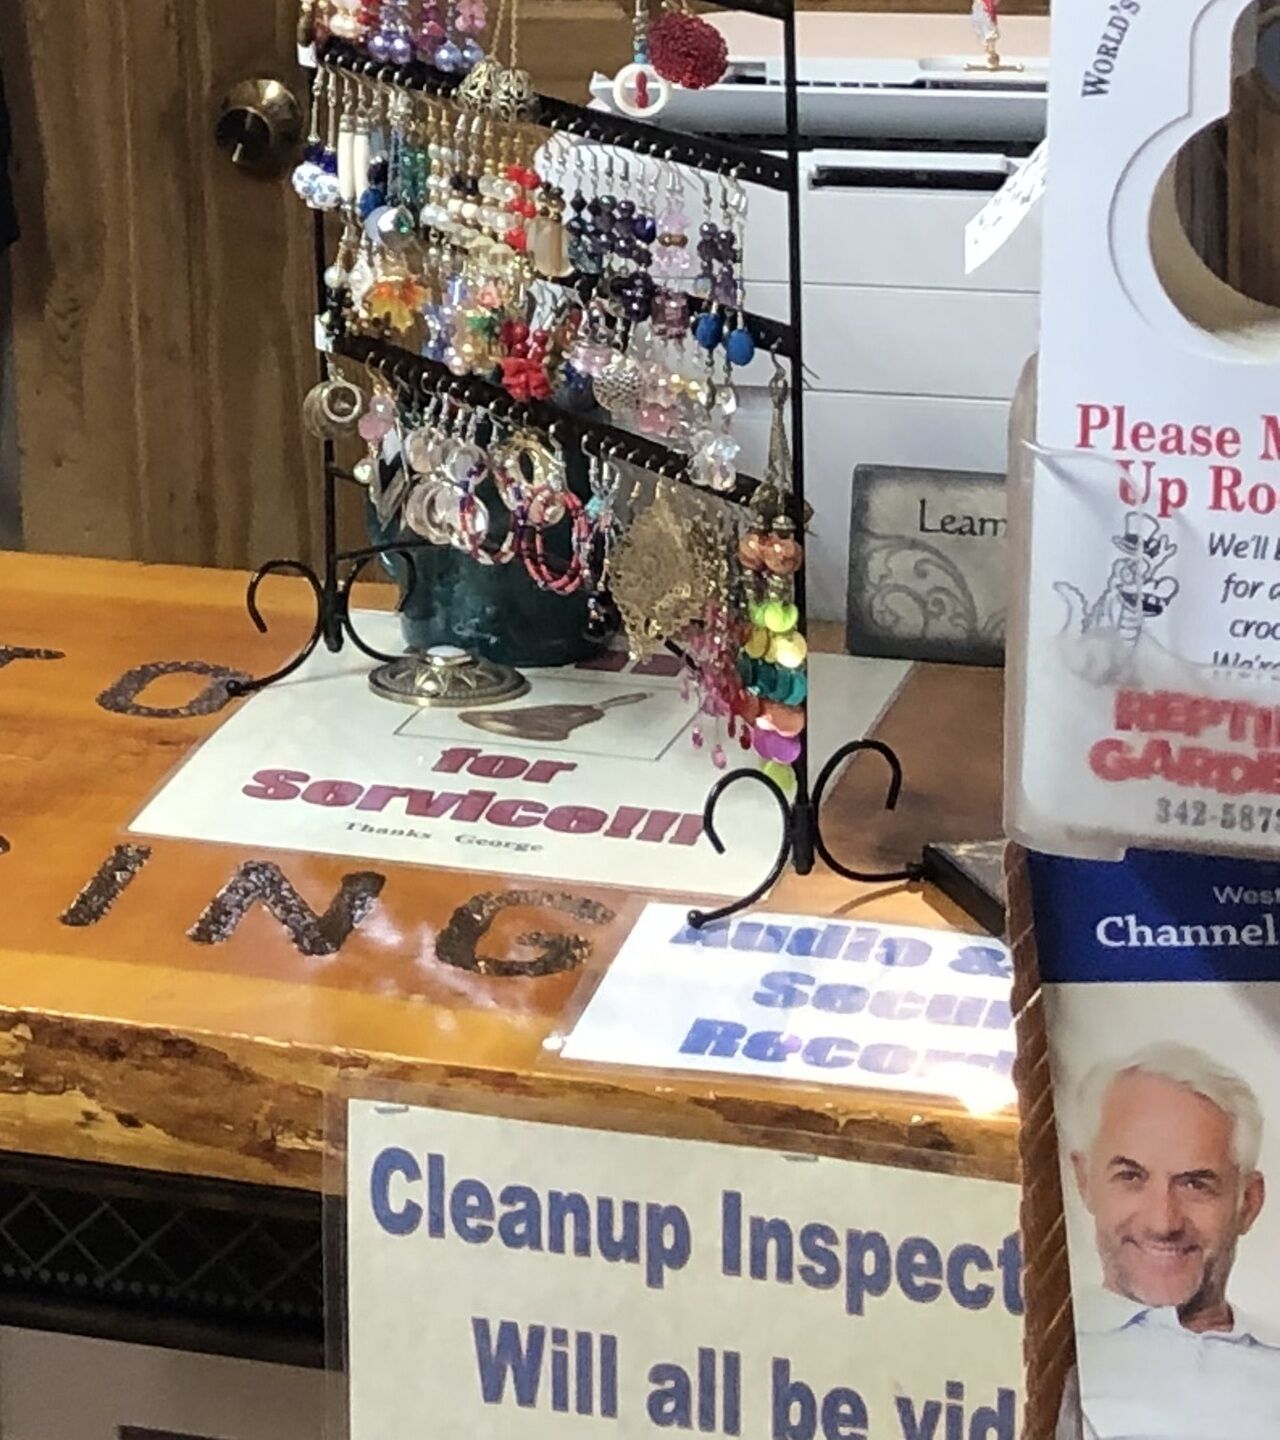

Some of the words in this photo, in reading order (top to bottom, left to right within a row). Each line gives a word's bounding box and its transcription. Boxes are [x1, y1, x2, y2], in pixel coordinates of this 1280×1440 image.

[1074, 403, 1242, 459] Please
[1115, 459, 1189, 519] Up
[1208, 531, 1270, 560] We'll
[1220, 572, 1265, 604] for
[1113, 689, 1280, 749] REPTI
[431, 746, 579, 785] for
[241, 767, 707, 848] Service!!!
[345, 820, 433, 840] Thanks
[453, 832, 545, 854] George
[1095, 912, 1280, 948] Channel
[368, 1145, 692, 1290] Cleanup
[721, 1190, 1027, 1317] Inspect
[470, 1316, 618, 1420] Will
[645, 1346, 741, 1437] all
[771, 1356, 870, 1440] be
